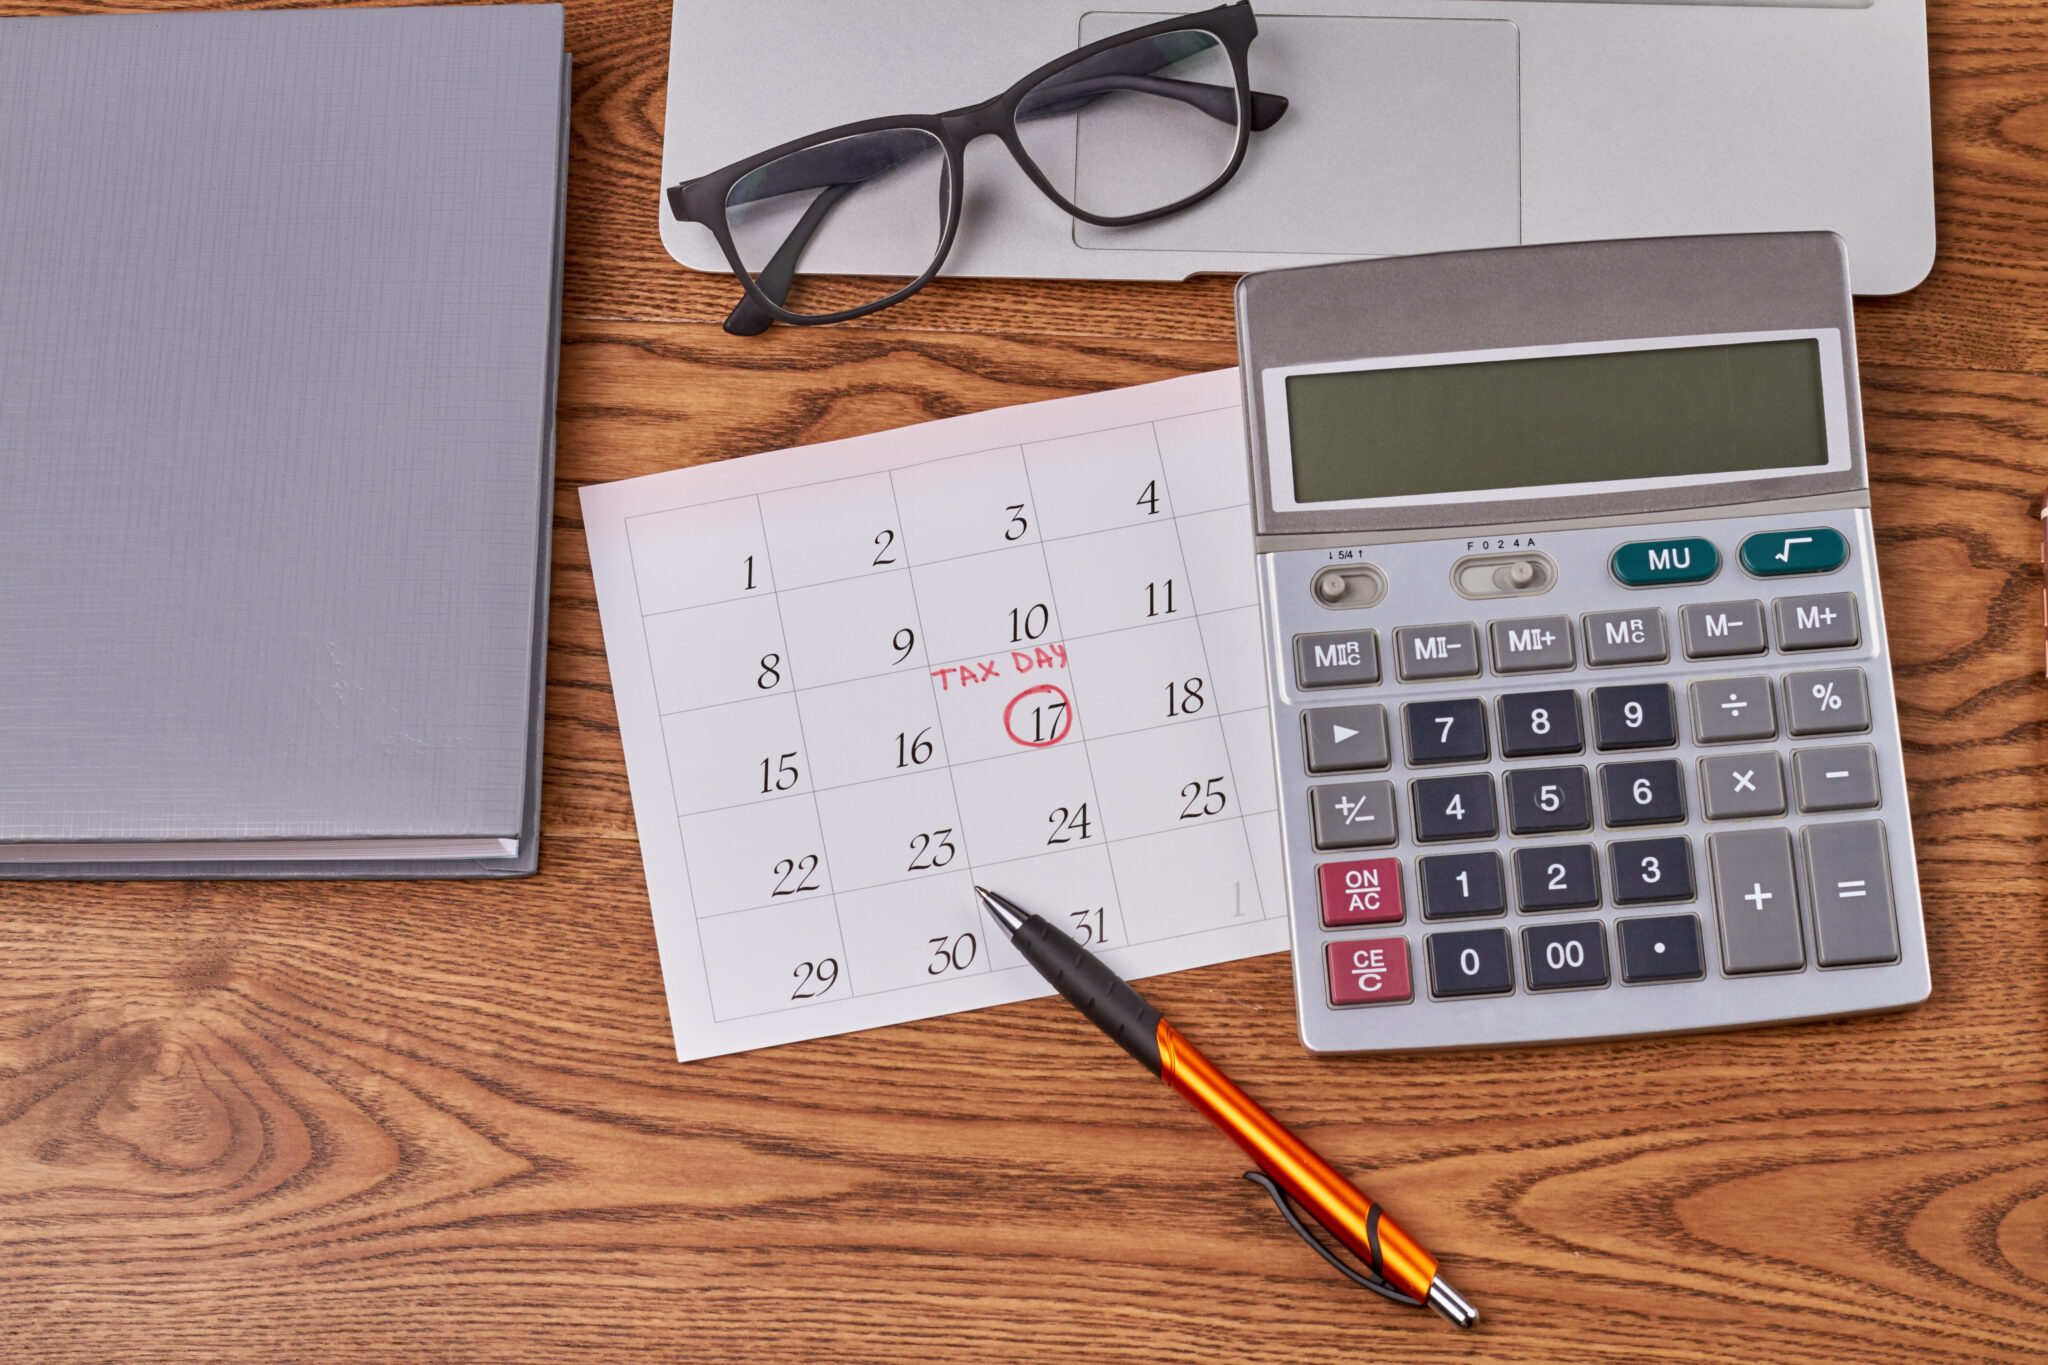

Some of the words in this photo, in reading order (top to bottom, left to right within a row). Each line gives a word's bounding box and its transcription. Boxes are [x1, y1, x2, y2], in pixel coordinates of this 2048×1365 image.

[744, 554, 758, 590] 1
[872, 529, 897, 567] 2
[1004, 503, 1029, 541] 3
[1135, 479, 1161, 516] 4
[1466, 541, 1475, 551] F
[1497, 539, 1505, 549] 2
[1513, 538, 1521, 548] 4
[1527, 537, 1536, 547] A
[1338, 551, 1354, 560] 5/4
[1648, 548, 1692, 571] MU
[1796, 605, 1838, 630] M+
[756, 653, 782, 690] 8
[891, 627, 916, 665] 9
[1009, 602, 1050, 643] 10
[1144, 578, 1178, 618] 11
[930, 660, 1002, 691] TAX
[1011, 643, 1069, 675] DAY
[1811, 682, 1843, 711] %
[1530, 708, 1552, 736] 8
[1623, 700, 1644, 728] 9
[759, 751, 800, 794] 15
[895, 726, 934, 768] 16
[1030, 702, 1068, 744] 17
[1164, 677, 1206, 718] 18
[1434, 716, 1455, 743] 7
[1540, 784, 1560, 812] 5
[1632, 778, 1653, 805] 6
[1445, 793, 1467, 820] 4
[771, 854, 820, 898] 22
[907, 828, 957, 873] 23
[1047, 802, 1092, 845] 24
[1178, 776, 1227, 820] 25
[1345, 868, 1380, 889] ON
[1547, 863, 1568, 891] 2
[1641, 856, 1662, 884] 3
[1455, 871, 1470, 898] 1
[1347, 892, 1381, 912] AC
[791, 957, 840, 1001] 29
[926, 932, 978, 976] 30
[1069, 906, 1109, 947] 31
[1231, 880, 1246, 919] 1
[1545, 940, 1585, 969] 00
[1353, 949, 1385, 969] CE
[1459, 947, 1481, 976] 0
[1358, 973, 1383, 993] C
